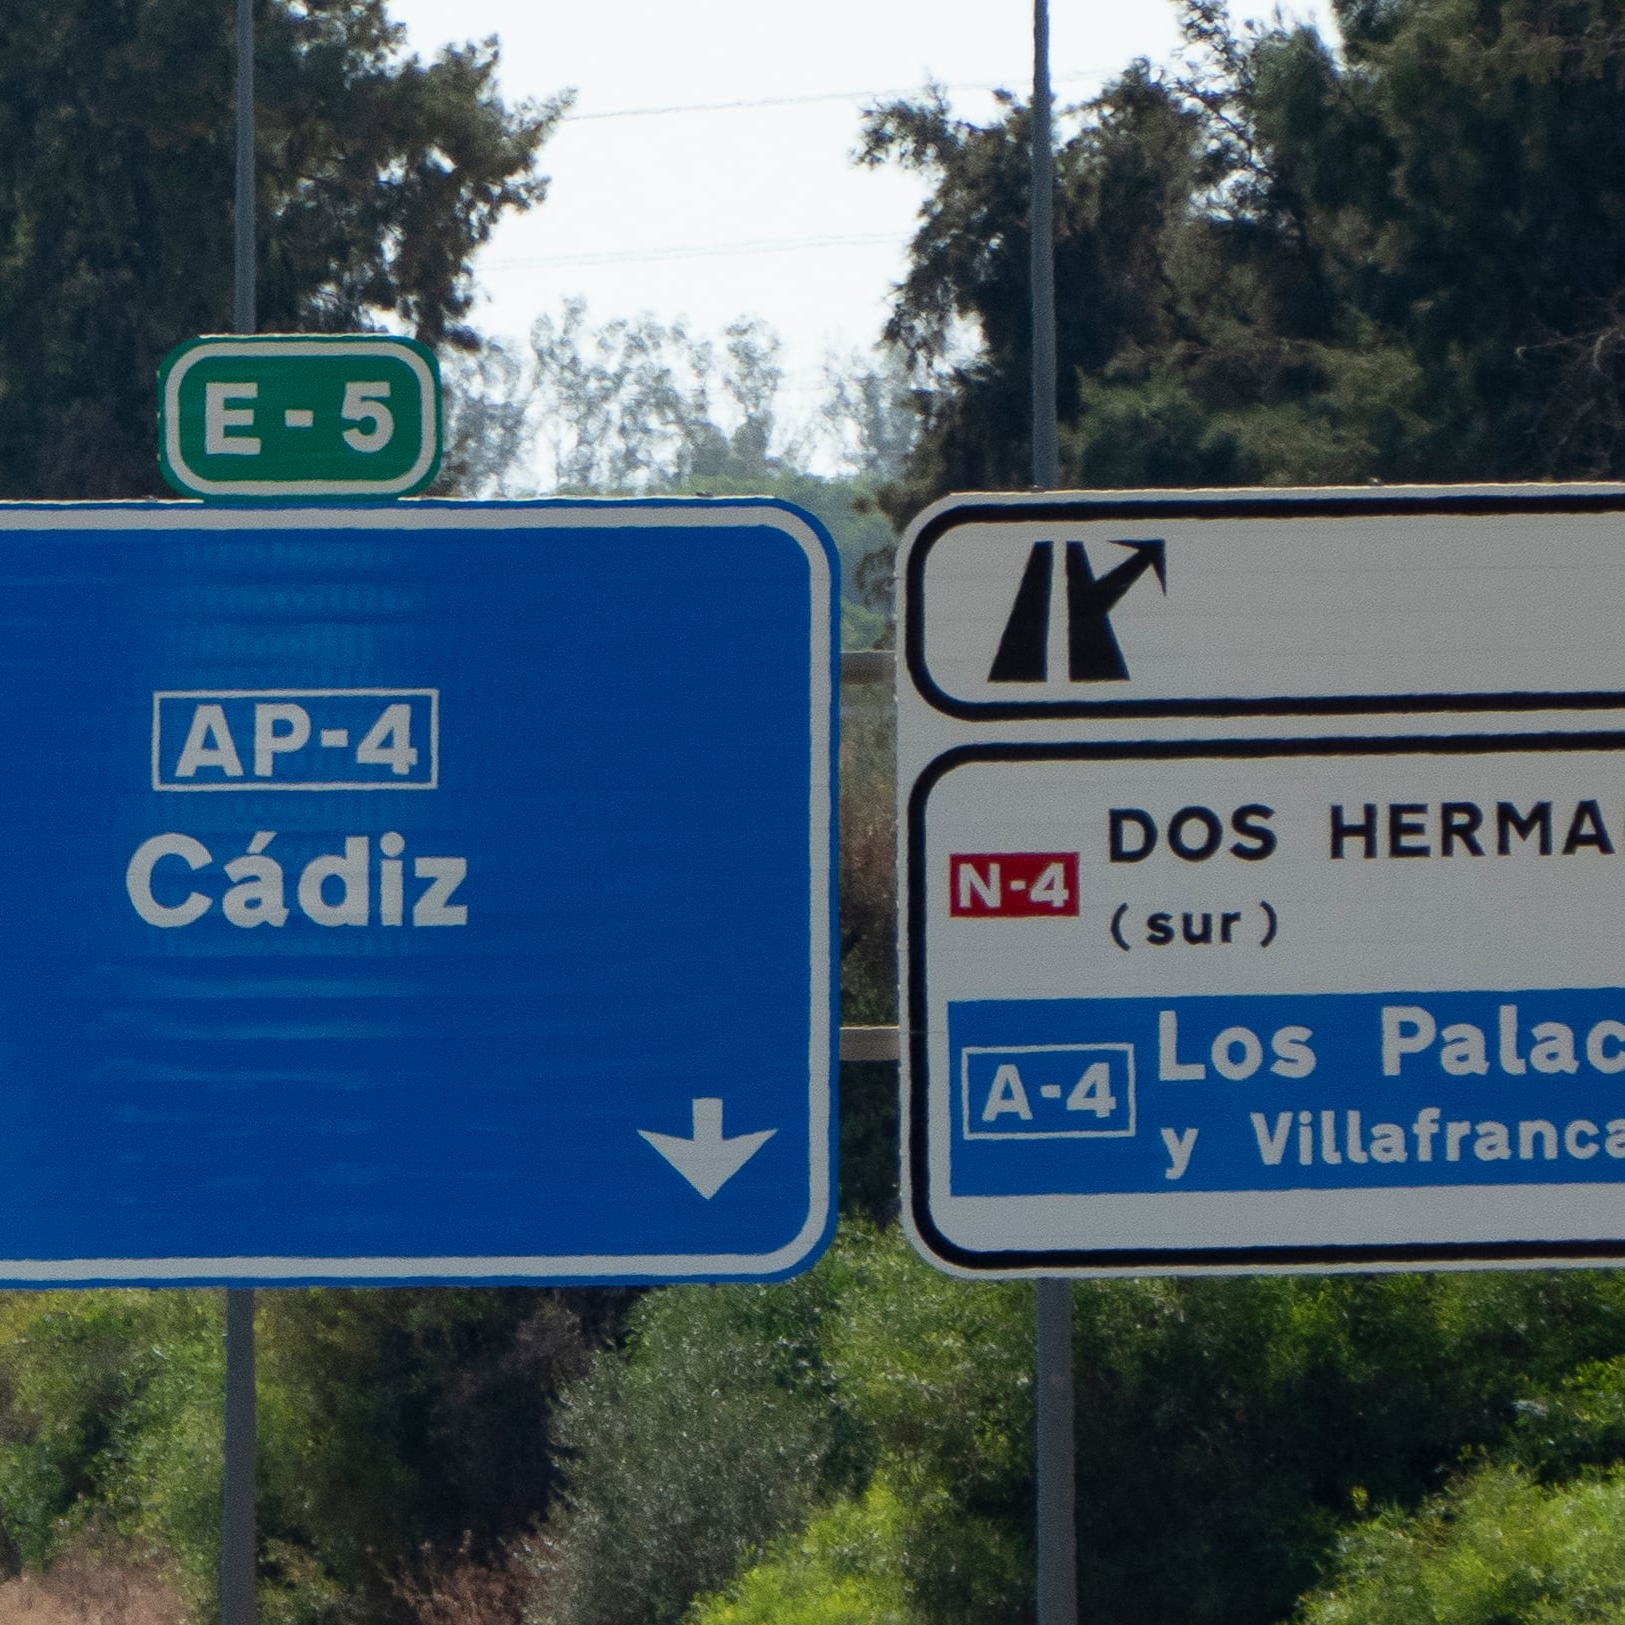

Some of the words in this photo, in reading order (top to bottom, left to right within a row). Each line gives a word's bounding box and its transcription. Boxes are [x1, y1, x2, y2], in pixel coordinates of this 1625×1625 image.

[173, 702, 419, 778] AP-4
[1108, 804, 1278, 863] DOS
[1329, 799, 1623, 860] HERMA
[125, 831, 468, 929] Cádiz
[958, 863, 1071, 910] N-4
[1110, 901, 1279, 951] (sur)
[1158, 1009, 1317, 1081] Los
[982, 1062, 1117, 1122] A-4
[1161, 1124, 1198, 1180] y
